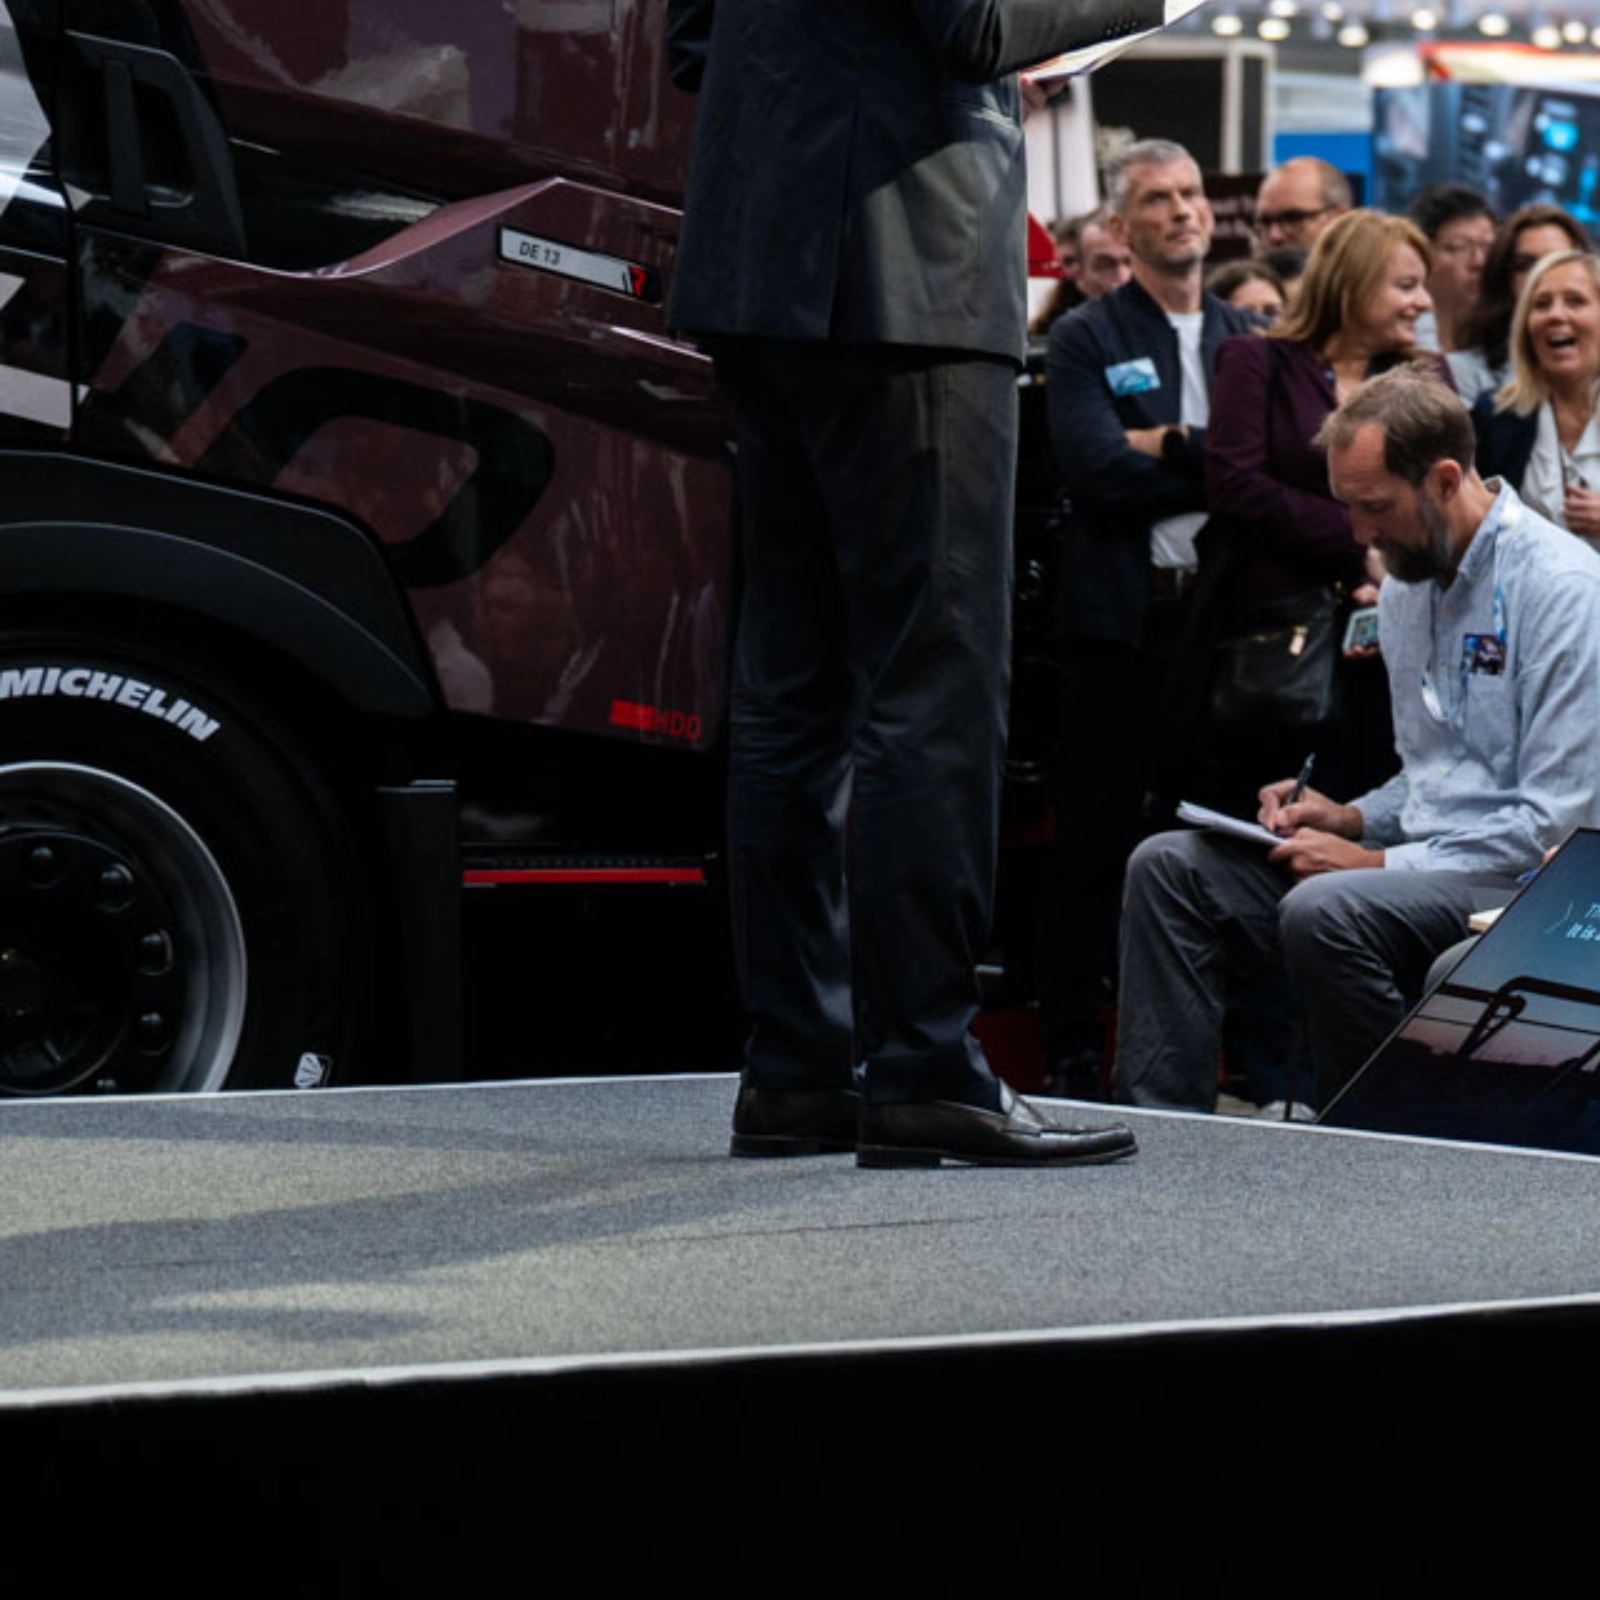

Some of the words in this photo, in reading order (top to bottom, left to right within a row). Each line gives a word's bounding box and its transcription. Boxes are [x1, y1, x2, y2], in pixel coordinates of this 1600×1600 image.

[519, 241, 540, 260] DE
[544, 249, 560, 266] 13
[0, 667, 220, 741] MICHELIN
[1566, 922, 1579, 939] It
[1579, 924, 1594, 940] is
